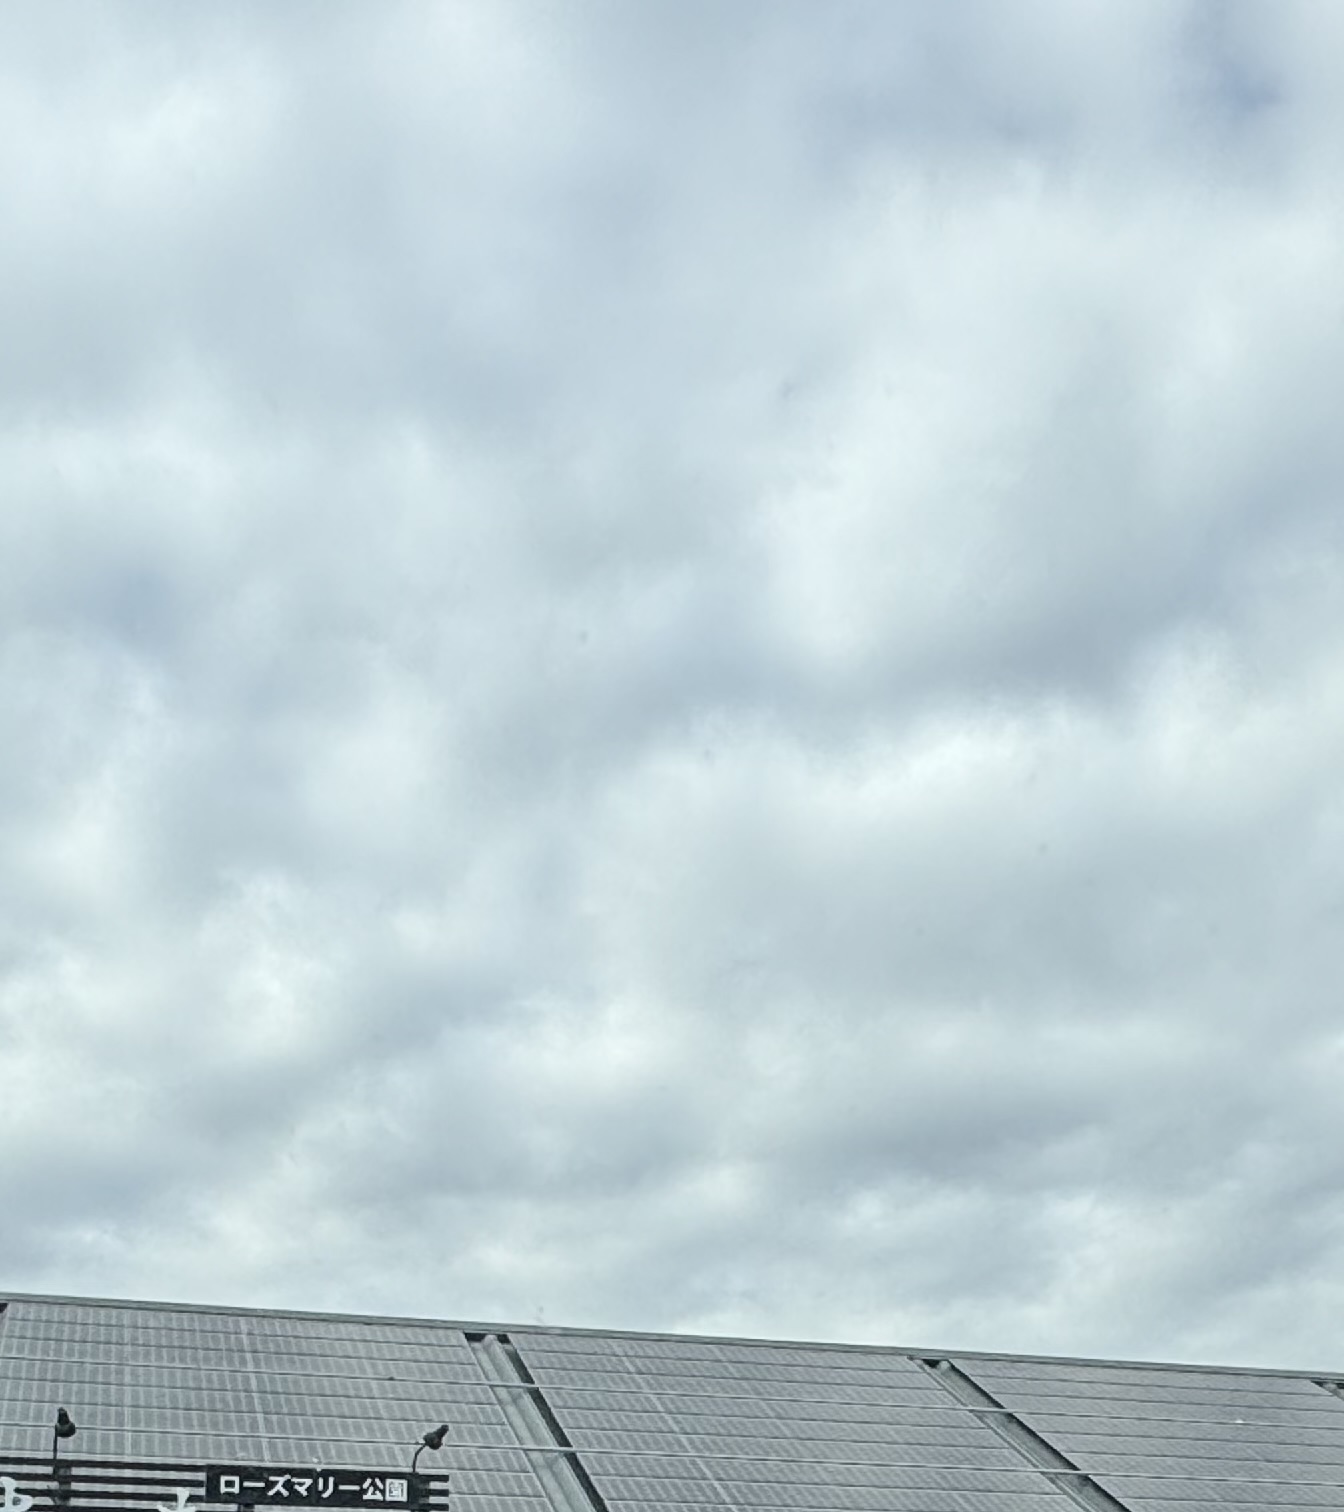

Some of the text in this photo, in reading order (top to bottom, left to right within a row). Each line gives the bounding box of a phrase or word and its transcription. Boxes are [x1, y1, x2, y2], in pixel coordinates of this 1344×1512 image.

[219, 1474, 408, 1502] ローズマリー公園
